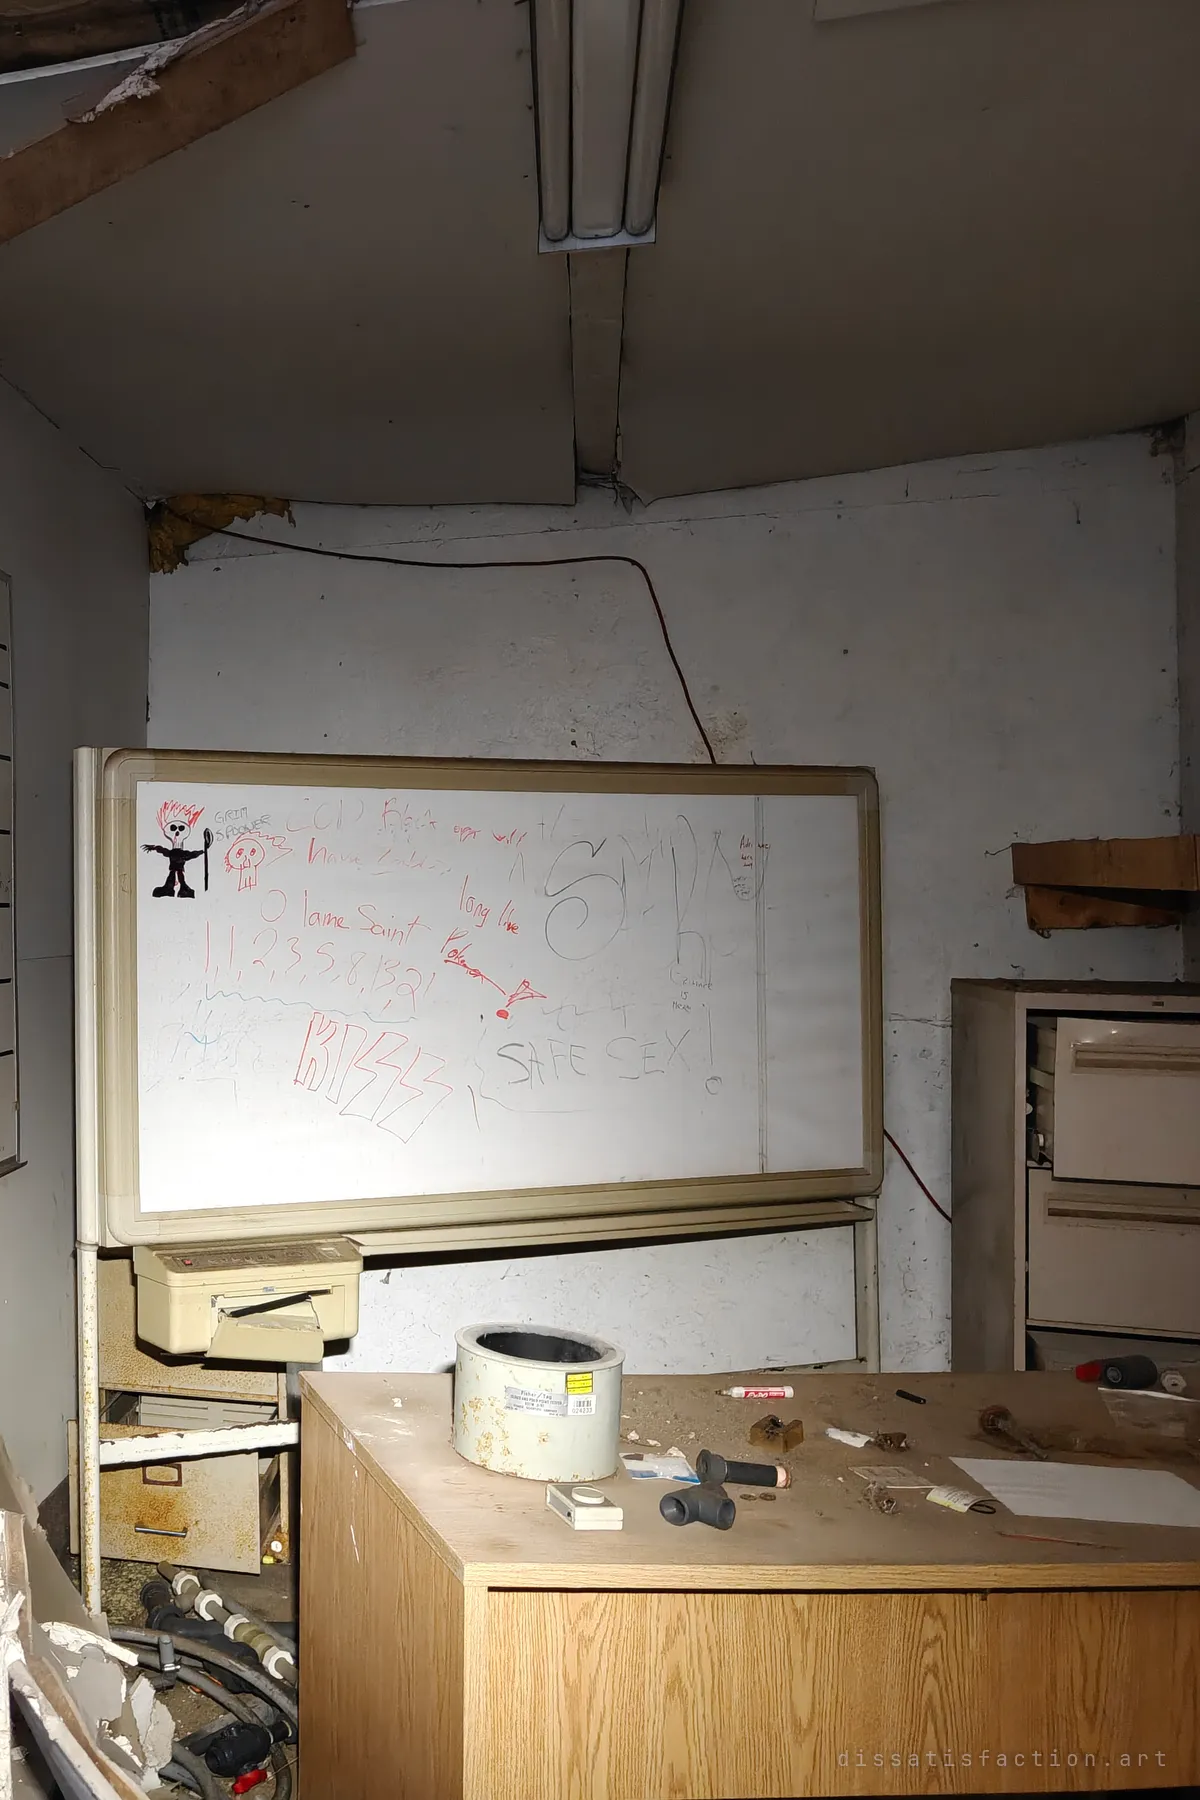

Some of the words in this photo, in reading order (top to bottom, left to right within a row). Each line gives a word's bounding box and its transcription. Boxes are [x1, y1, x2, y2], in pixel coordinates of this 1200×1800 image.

[214, 806, 248, 824] GRIM
[303, 888, 351, 930] lame
[357, 903, 432, 946] Saint
[459, 874, 491, 928] long
[496, 1038, 588, 1090] SAFE
